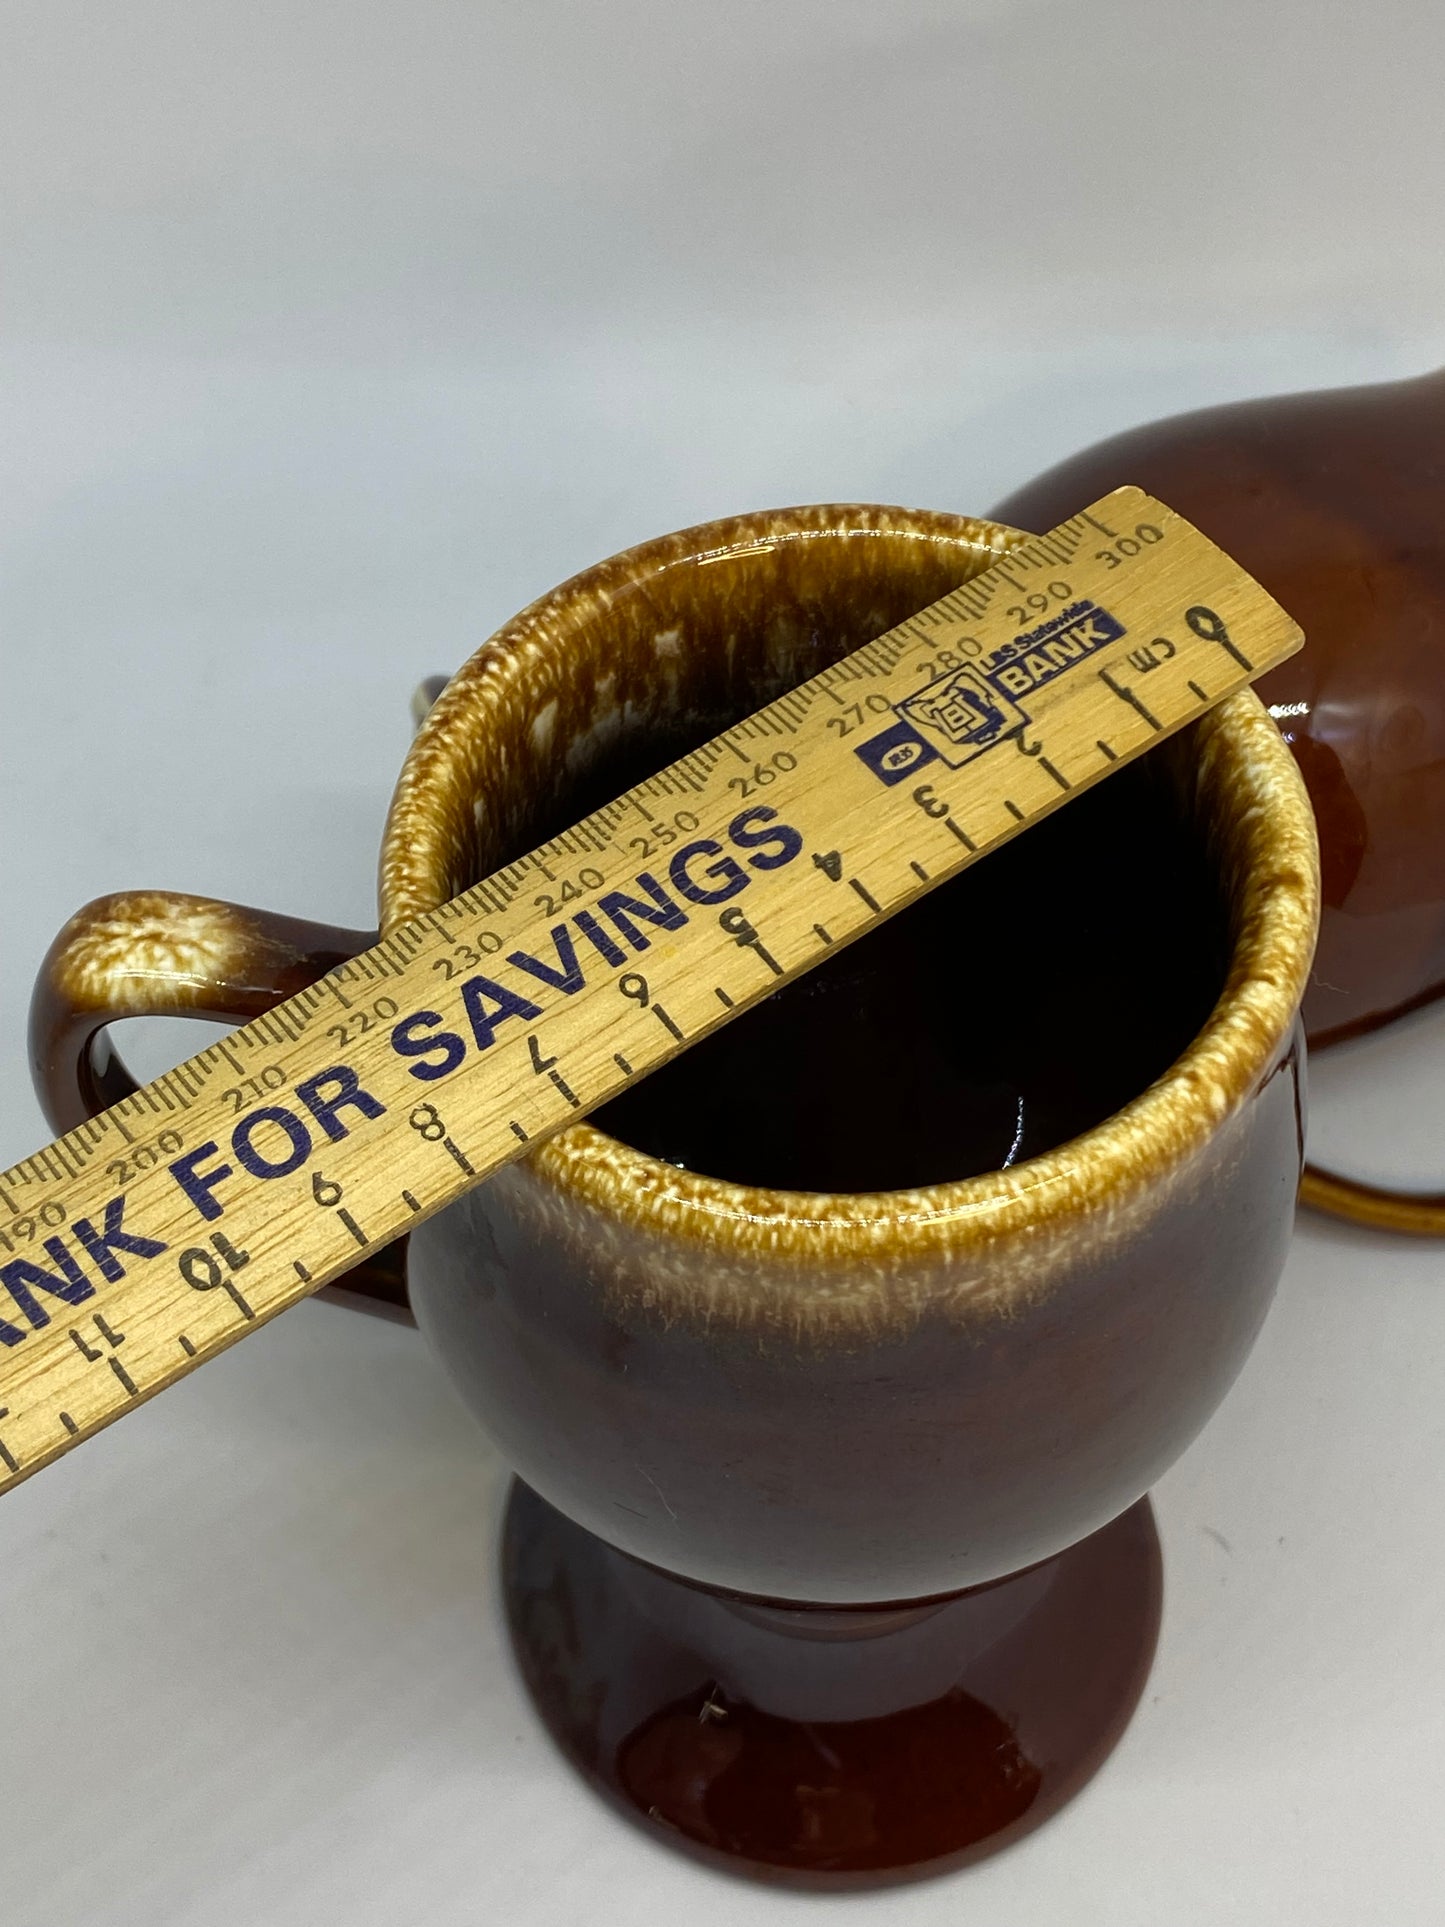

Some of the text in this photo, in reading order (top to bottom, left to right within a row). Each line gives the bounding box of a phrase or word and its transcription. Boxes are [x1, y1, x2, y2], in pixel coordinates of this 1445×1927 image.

[1185, 606, 1227, 642] 0
[998, 617, 1110, 697] BANK
[1127, 637, 1176, 673] cm
[912, 785, 949, 818] 3
[106, 1129, 184, 1185] 200
[221, 1065, 288, 1113] 210
[326, 995, 399, 1046] 220
[432, 930, 503, 980] 230
[534, 868, 605, 917] 240
[629, 810, 700, 858] 250
[728, 750, 798, 798] 260
[827, 694, 893, 738] 270
[917, 636, 983, 681] 280
[1007, 581, 1074, 625] 290
[1096, 523, 1164, 569] 300
[812, 850, 843, 882] 4
[719, 907, 759, 947] 5
[619, 973, 649, 1007] 6
[528, 1035, 558, 1075] 7
[0, 805, 803, 1347] NK FOR SAVINGS
[409, 1102, 446, 1142] 8
[312, 1172, 343, 1207] 9
[178, 1231, 250, 1291] 10
[68, 1313, 125, 1362] 11
